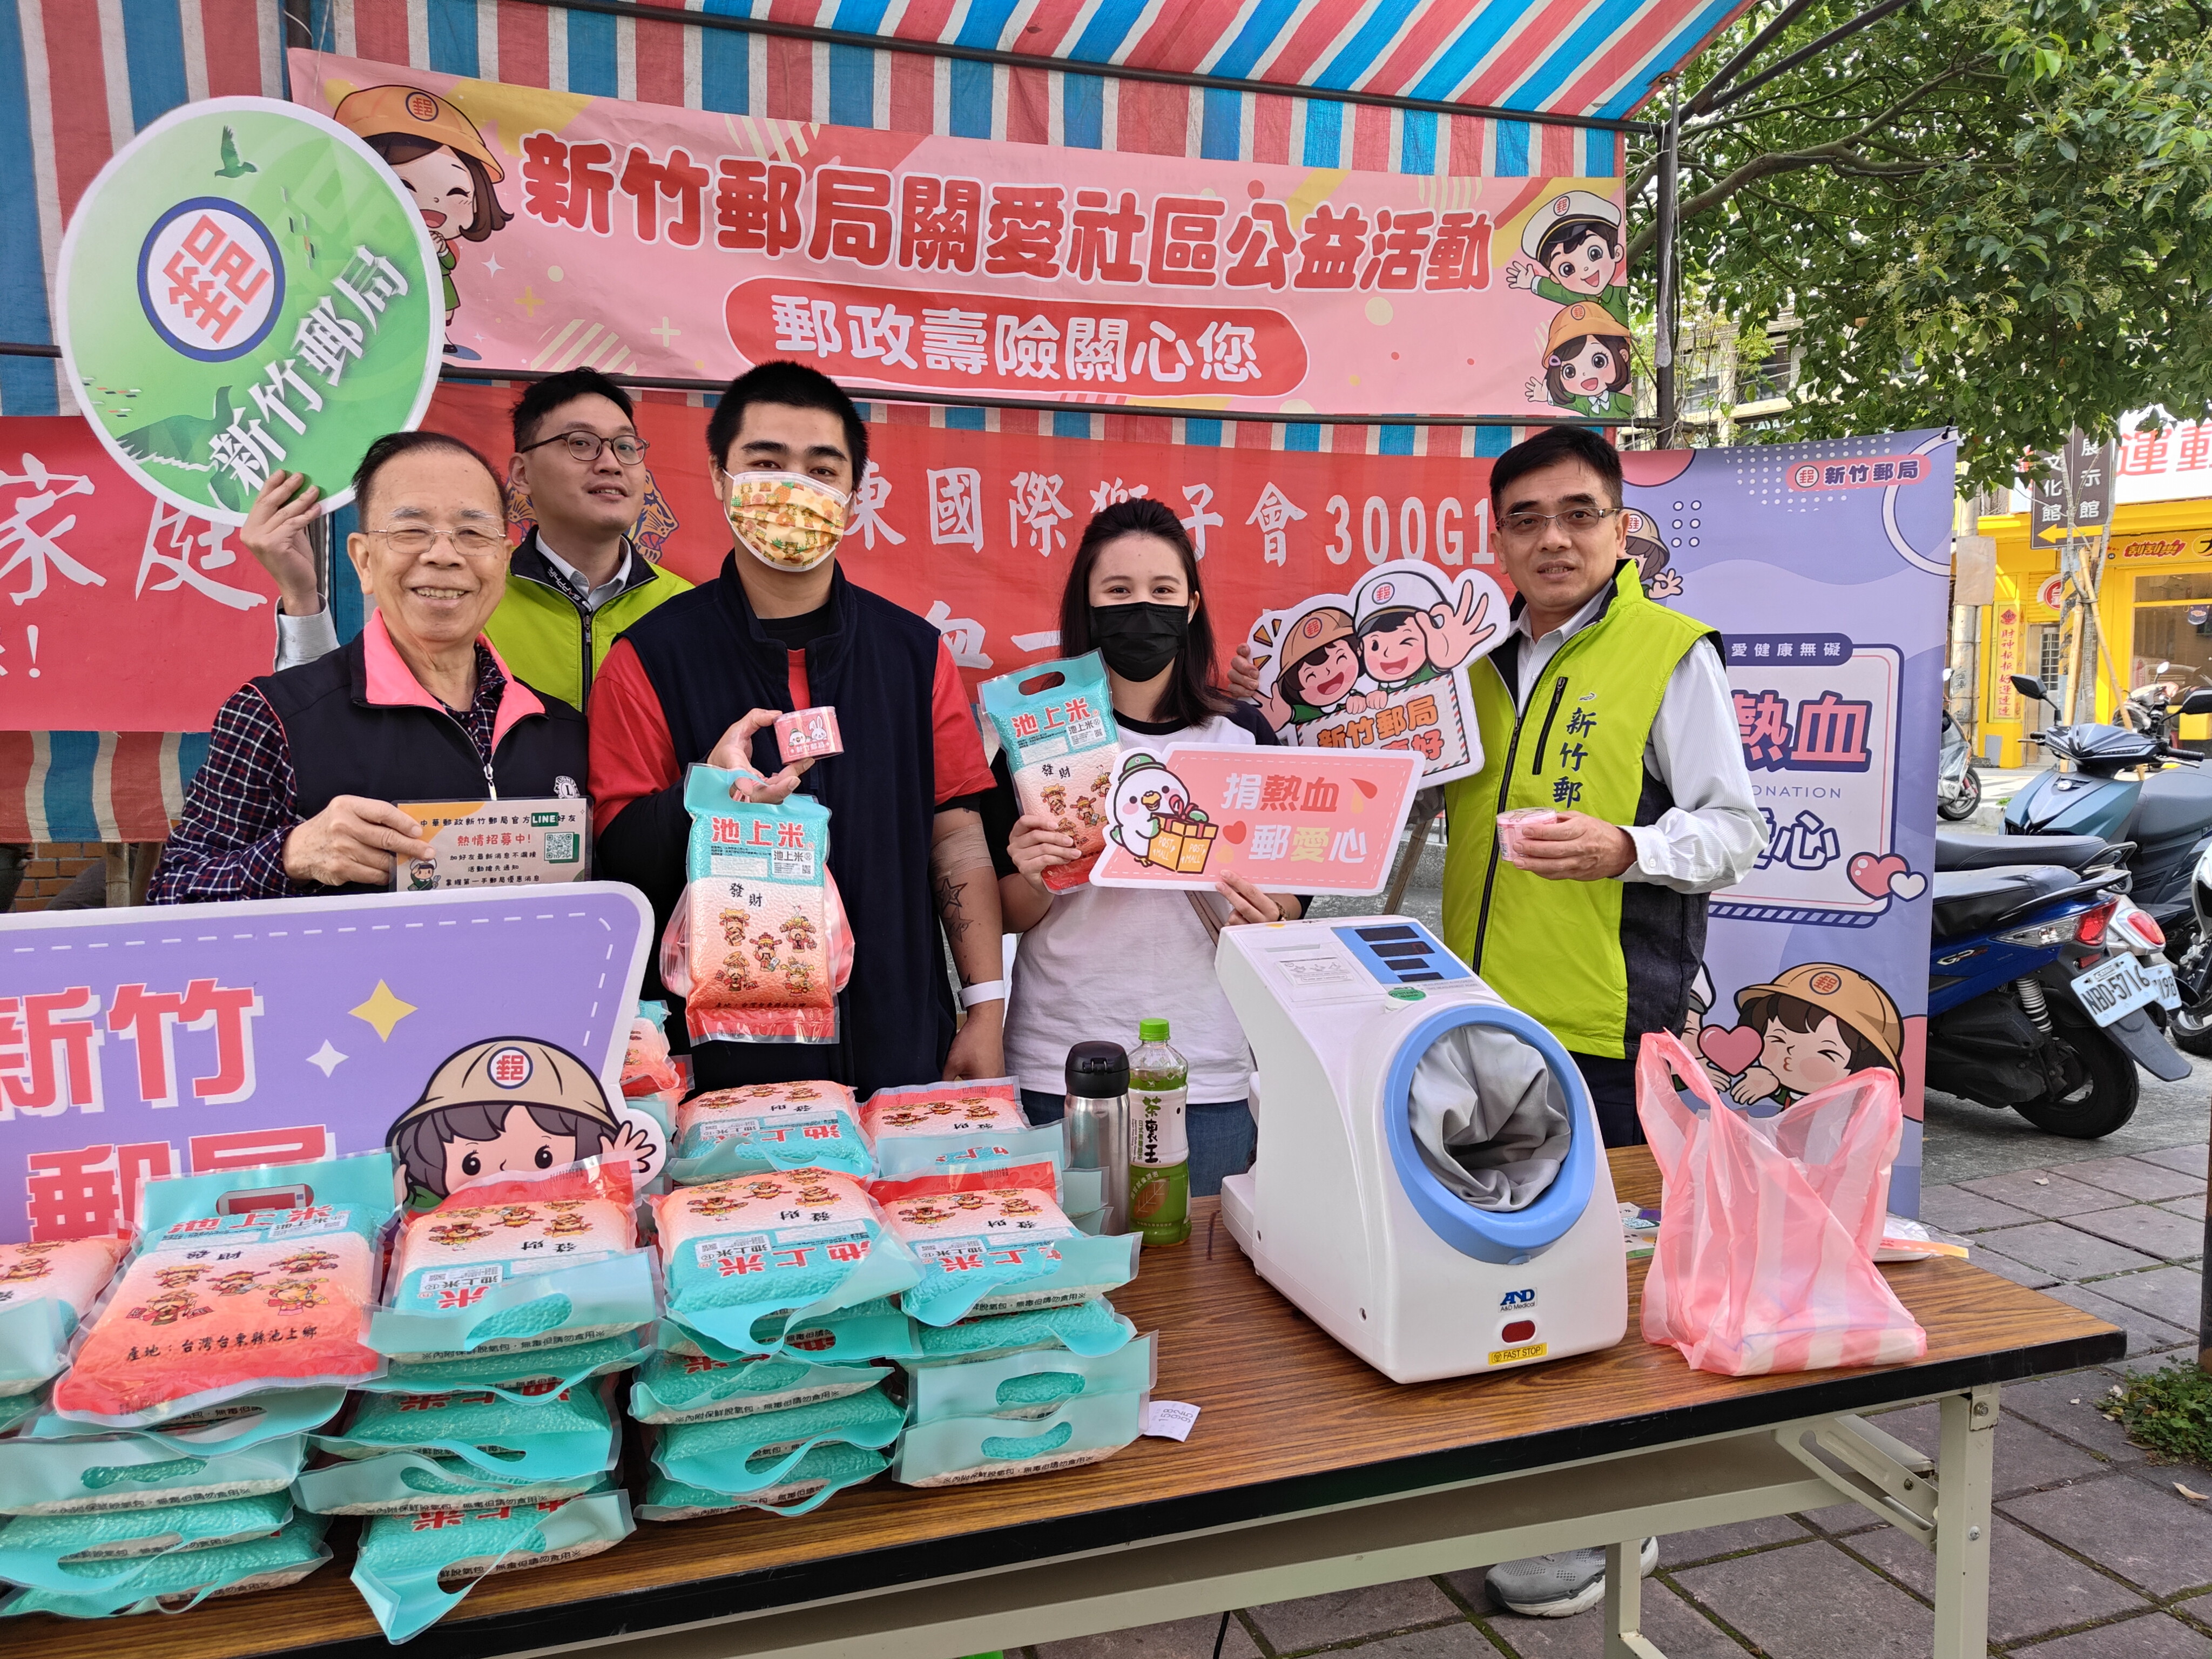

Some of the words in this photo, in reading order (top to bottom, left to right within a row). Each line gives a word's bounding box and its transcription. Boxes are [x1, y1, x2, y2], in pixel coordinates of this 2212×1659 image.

[521, 131, 1494, 292] 新竹郵局關愛社區公益活動
[771, 294, 1263, 384] 郵政壽險關心您
[208, 245, 409, 497] 新竹郵局
[1824, 461, 1919, 485] 新竹郵局
[1731, 643, 1841, 657] 愛健康無礙
[1317, 694, 1439, 750] 新竹郵局
[1731, 693, 1869, 765] 熱血
[1042, 764, 1071, 778] 發財
[565, 785, 574, 796] L
[1221, 773, 1340, 812] 捐熱血
[1156, 848, 1169, 860] MALL
[1158, 837, 1174, 848] POST
[1189, 844, 1204, 853] POST
[1249, 824, 1367, 864] 郵愛心
[1185, 854, 1201, 864] MALL
[729, 883, 763, 907] 發財
[2081, 966, 2150, 1015] NBD-5716
[1514, 1301, 1535, 1310] Medical
[1503, 1350, 1521, 1360] FAST
[1522, 1346, 1541, 1356] STOP
